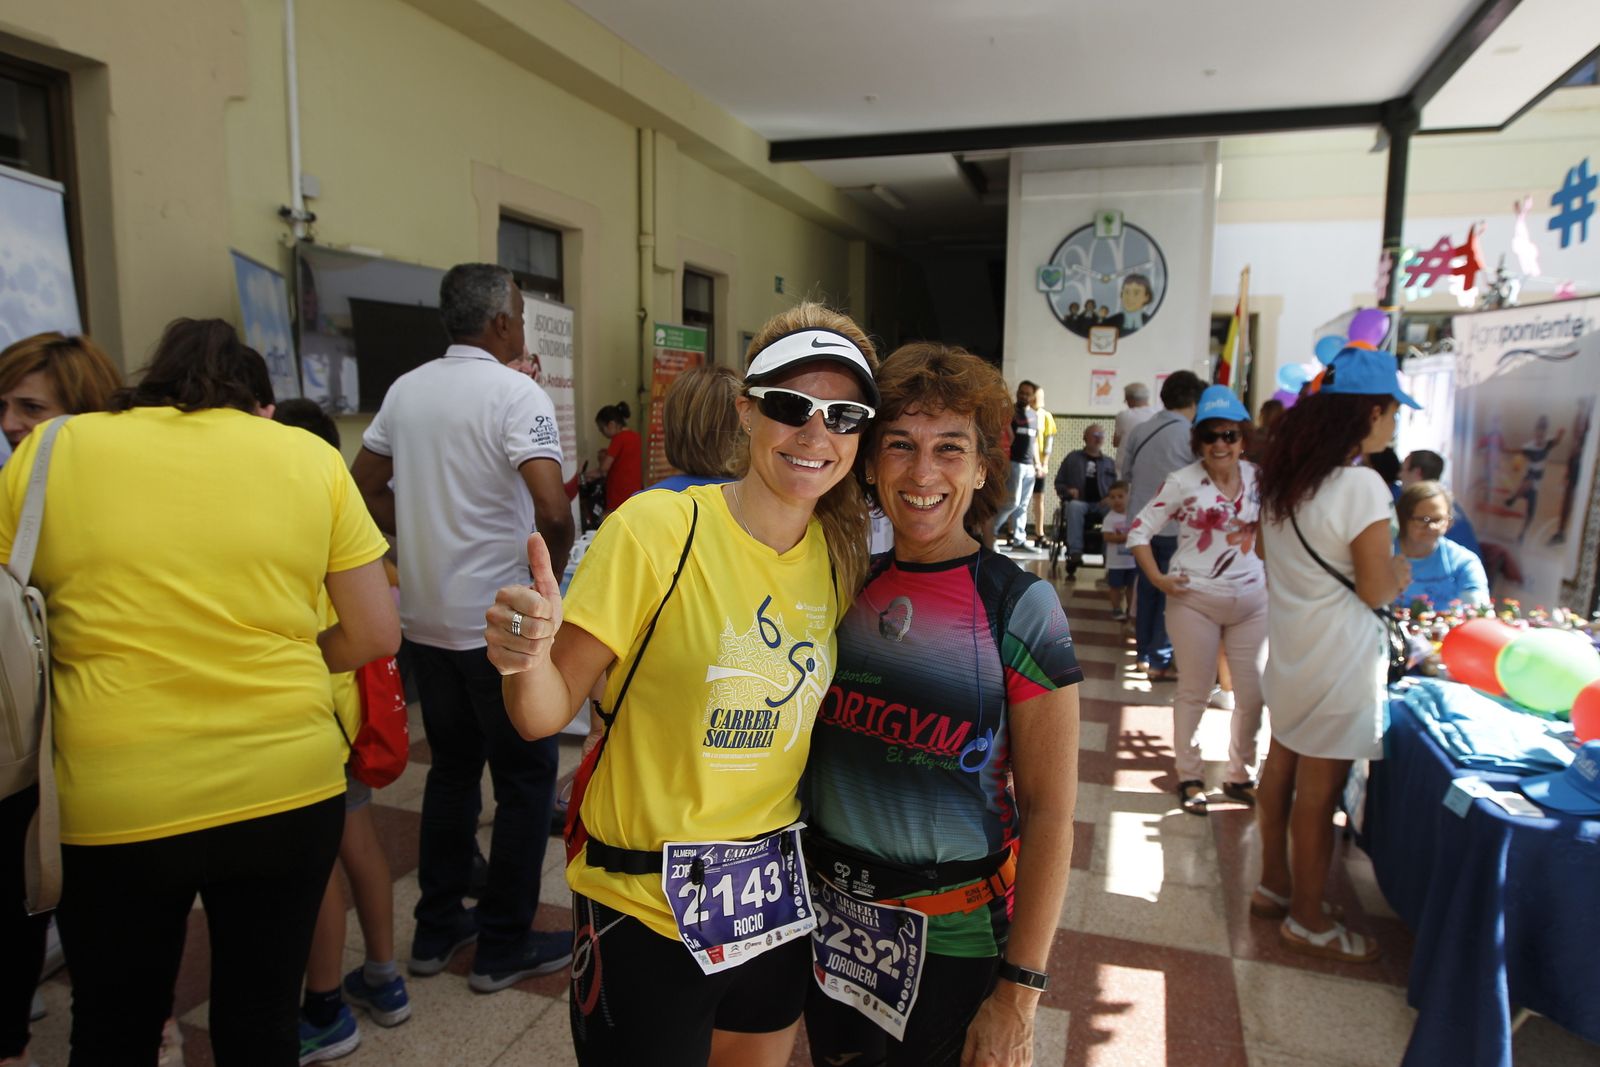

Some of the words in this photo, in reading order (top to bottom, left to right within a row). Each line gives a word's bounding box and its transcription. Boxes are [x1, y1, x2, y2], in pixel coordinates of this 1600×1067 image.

[710, 708, 781, 730] CARRERA
[817, 684, 974, 757] ORTGYM
[703, 728, 775, 749] SOLIDARIA
[678, 860, 783, 927] 2143
[733, 912, 765, 937] ROCIO
[812, 902, 902, 980] 2232
[825, 952, 878, 990] JORQUERA
